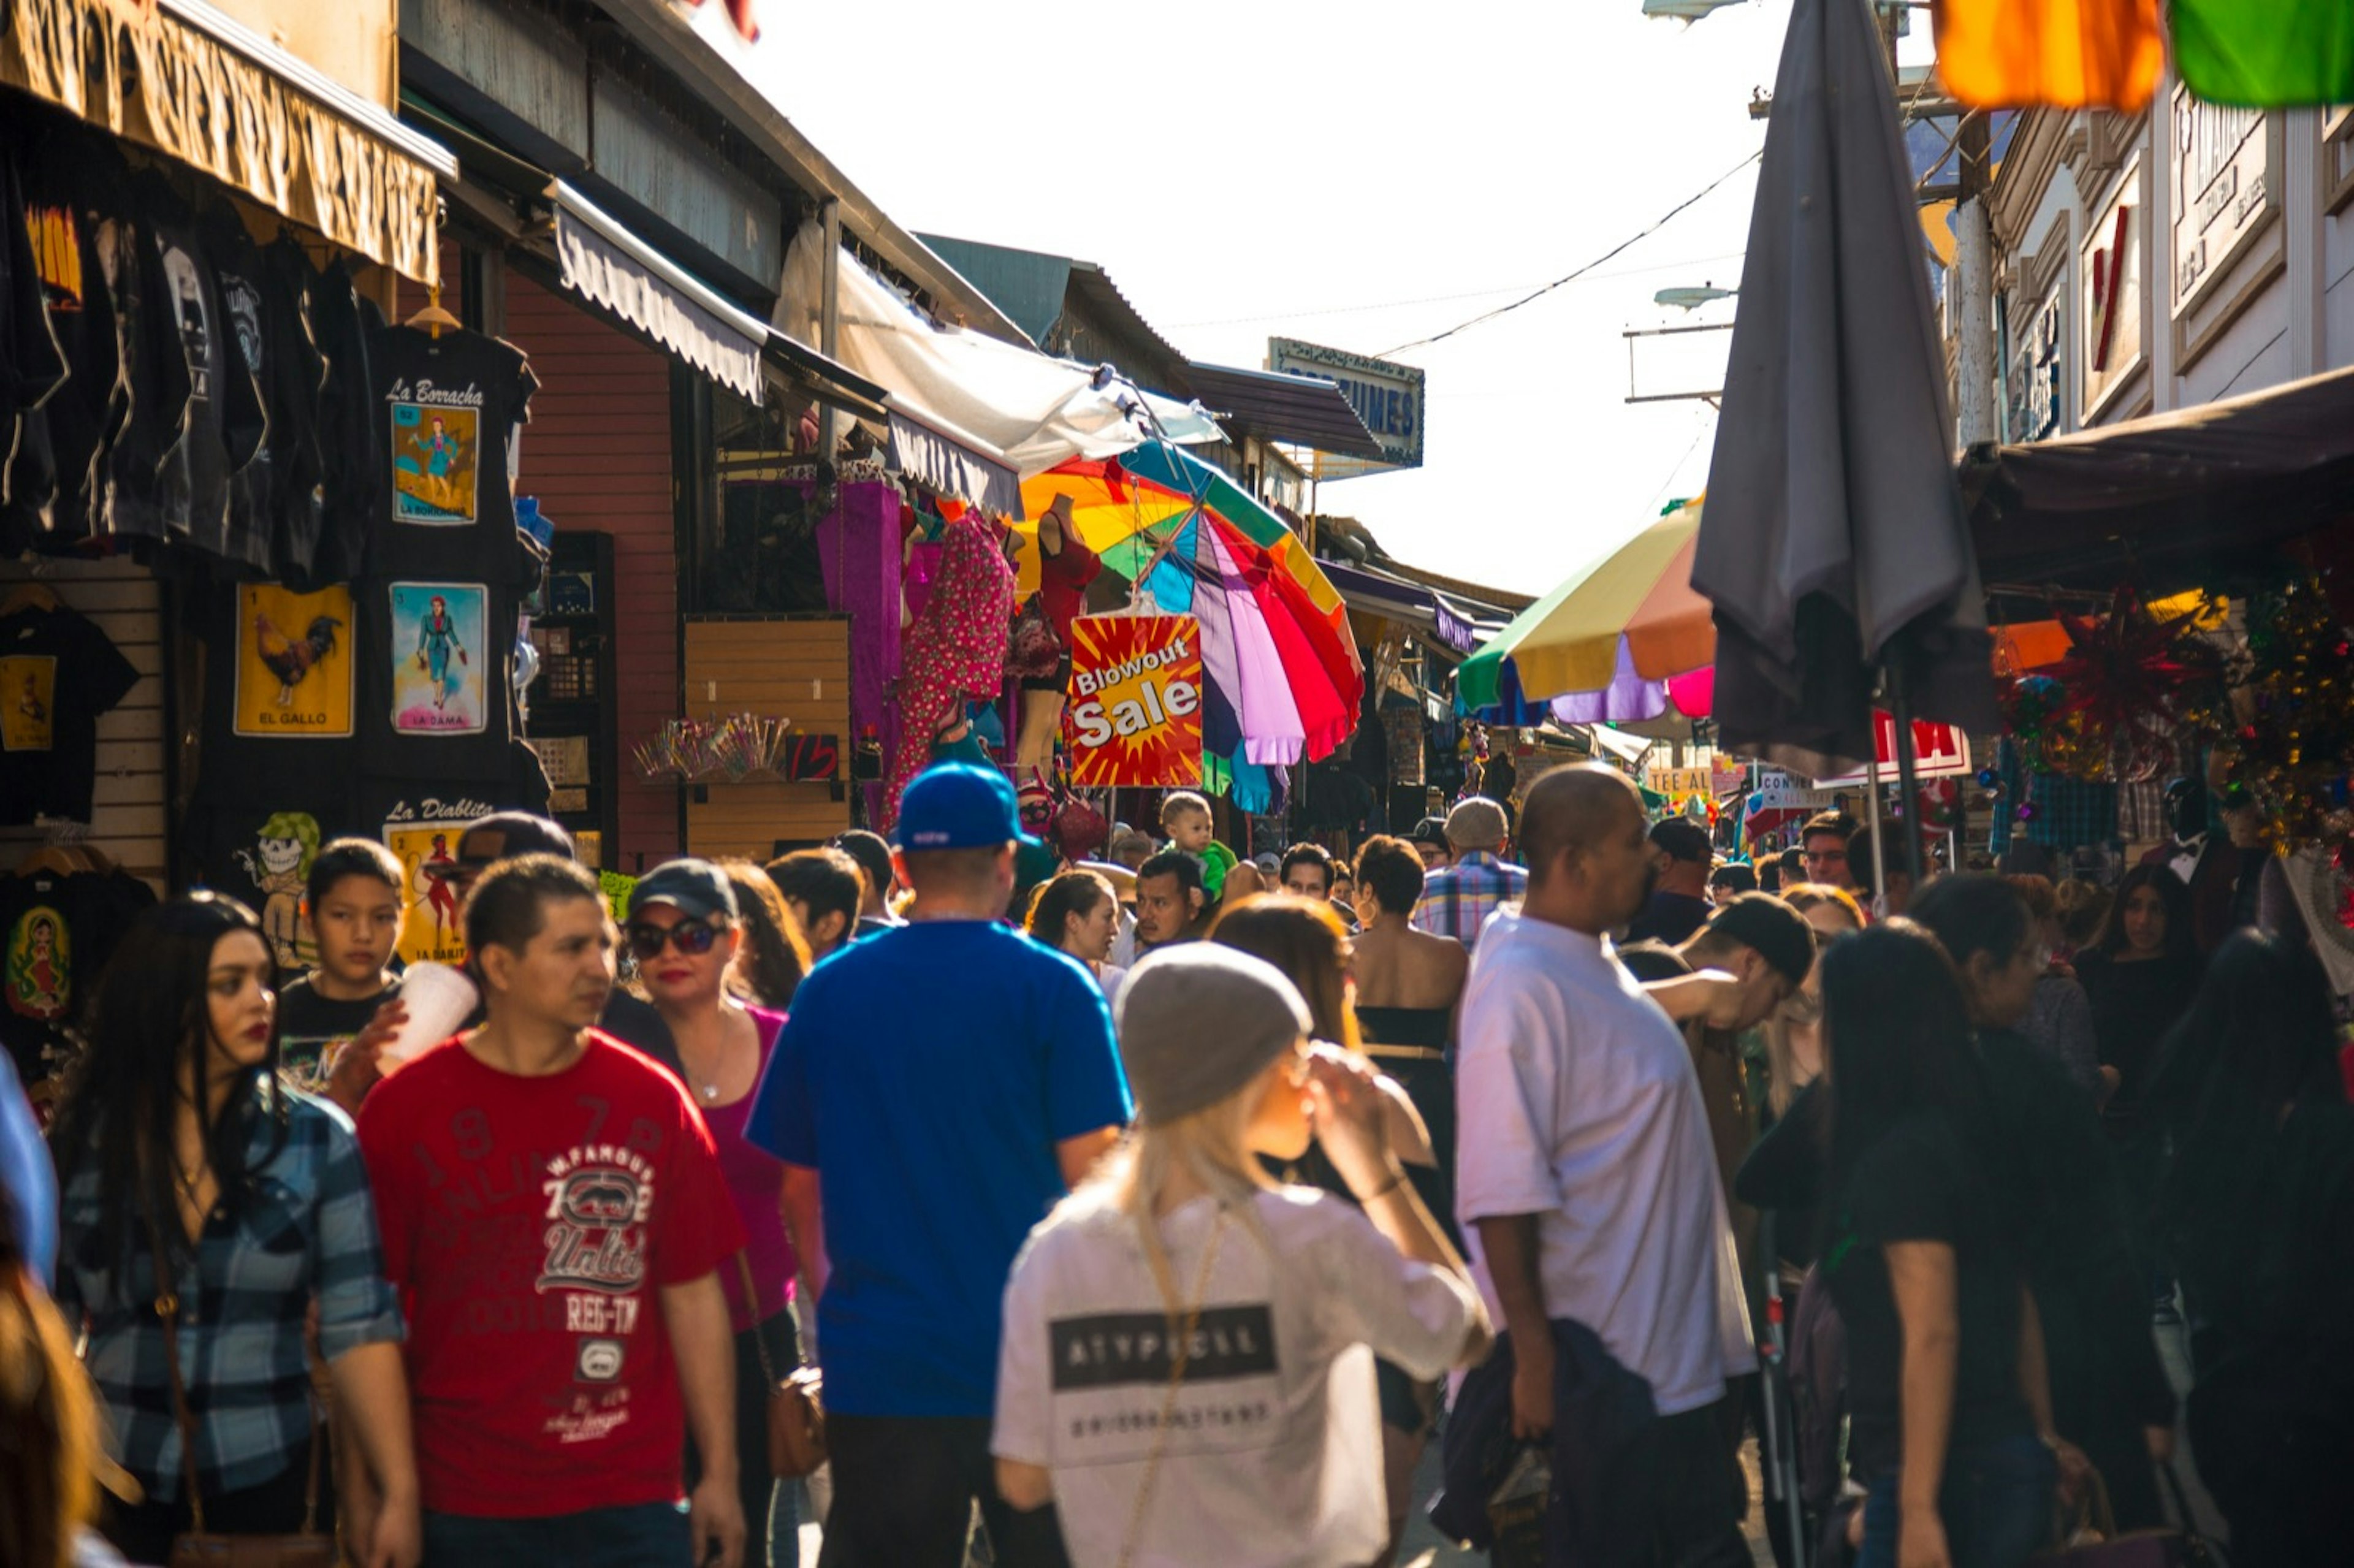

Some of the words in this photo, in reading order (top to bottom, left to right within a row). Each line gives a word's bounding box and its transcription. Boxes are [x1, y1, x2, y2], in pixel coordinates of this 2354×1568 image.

[386, 378, 411, 401] La
[416, 379, 484, 405] Borracha
[250, 593, 257, 605] 1
[1076, 637, 1189, 696] Blowout
[260, 713, 276, 725] EL
[281, 712, 327, 725] GALLO
[413, 716, 427, 725] LA
[430, 716, 463, 725] DAMA
[1074, 680, 1198, 748] Sale
[386, 800, 414, 821] La
